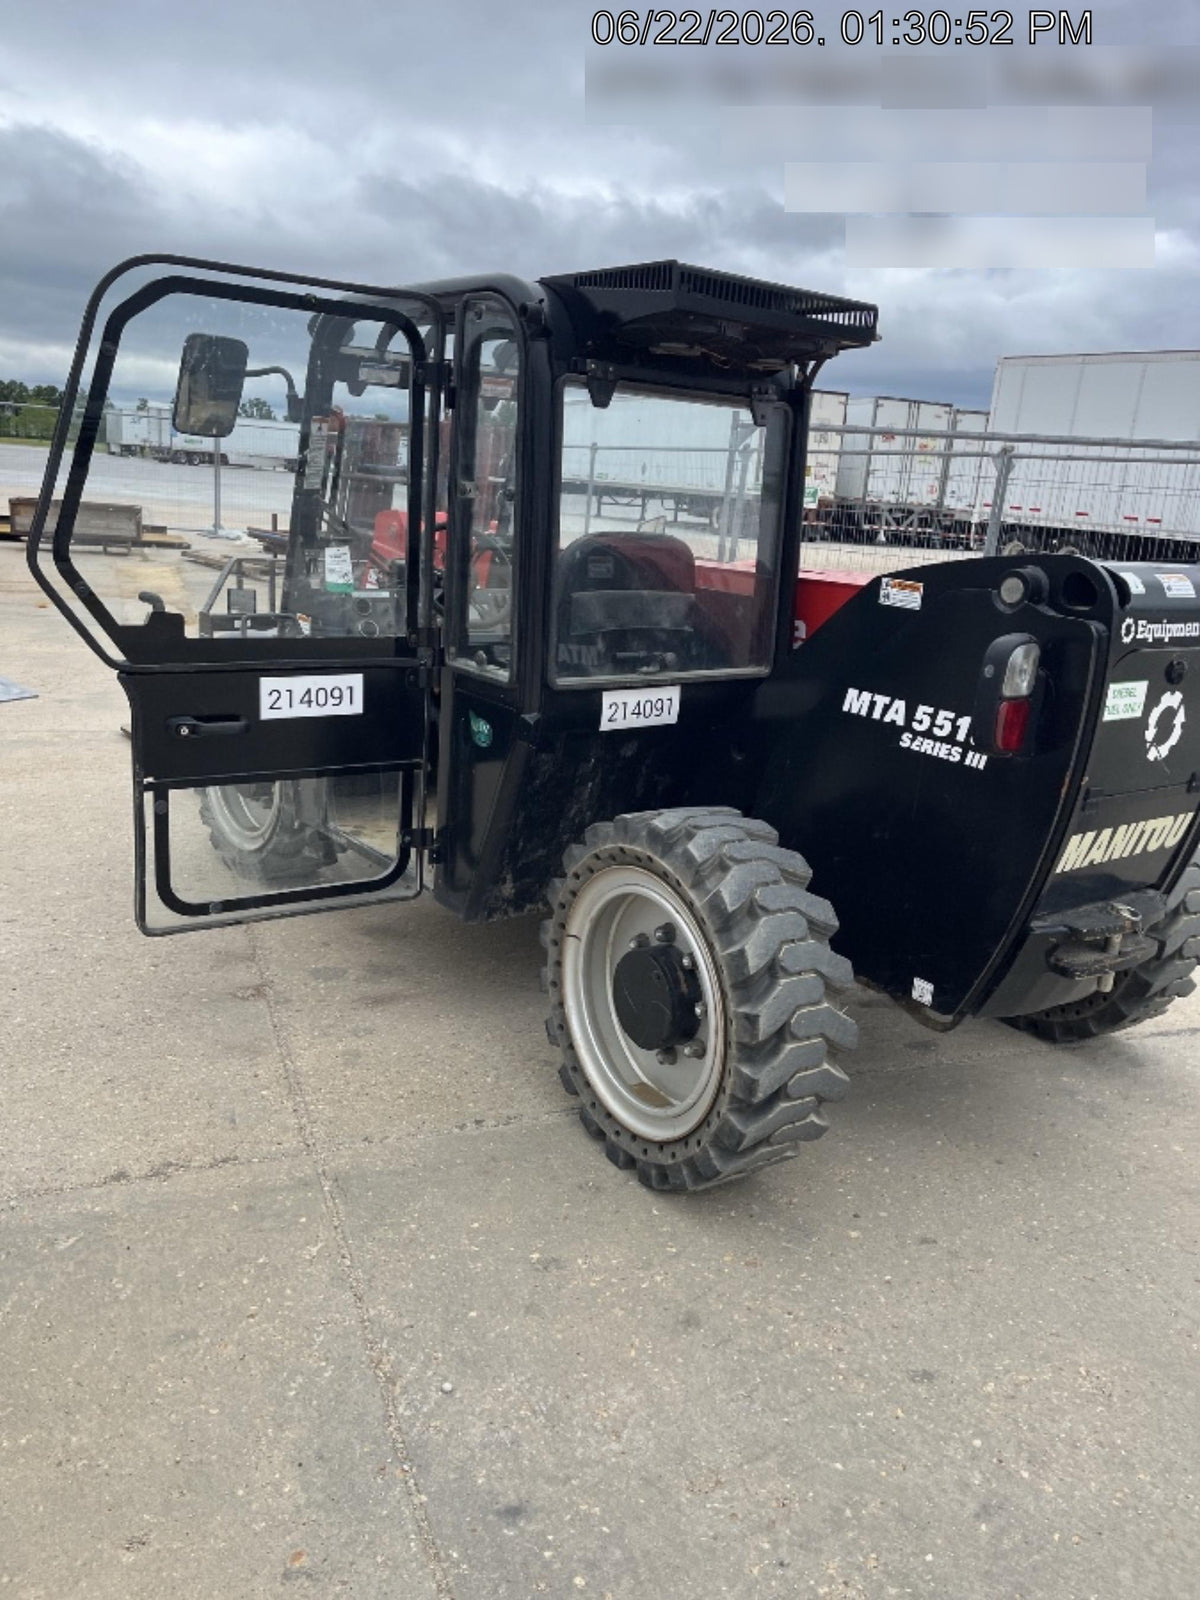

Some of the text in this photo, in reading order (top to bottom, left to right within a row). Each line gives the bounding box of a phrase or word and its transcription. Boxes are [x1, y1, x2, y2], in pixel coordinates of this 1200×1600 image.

[267, 685, 354, 710] 214091
[607, 697, 673, 723] 214091
[841, 687, 976, 746] MTA 551
[899, 732, 989, 770] SERIES III
[1055, 811, 1196, 875] MANITOU
